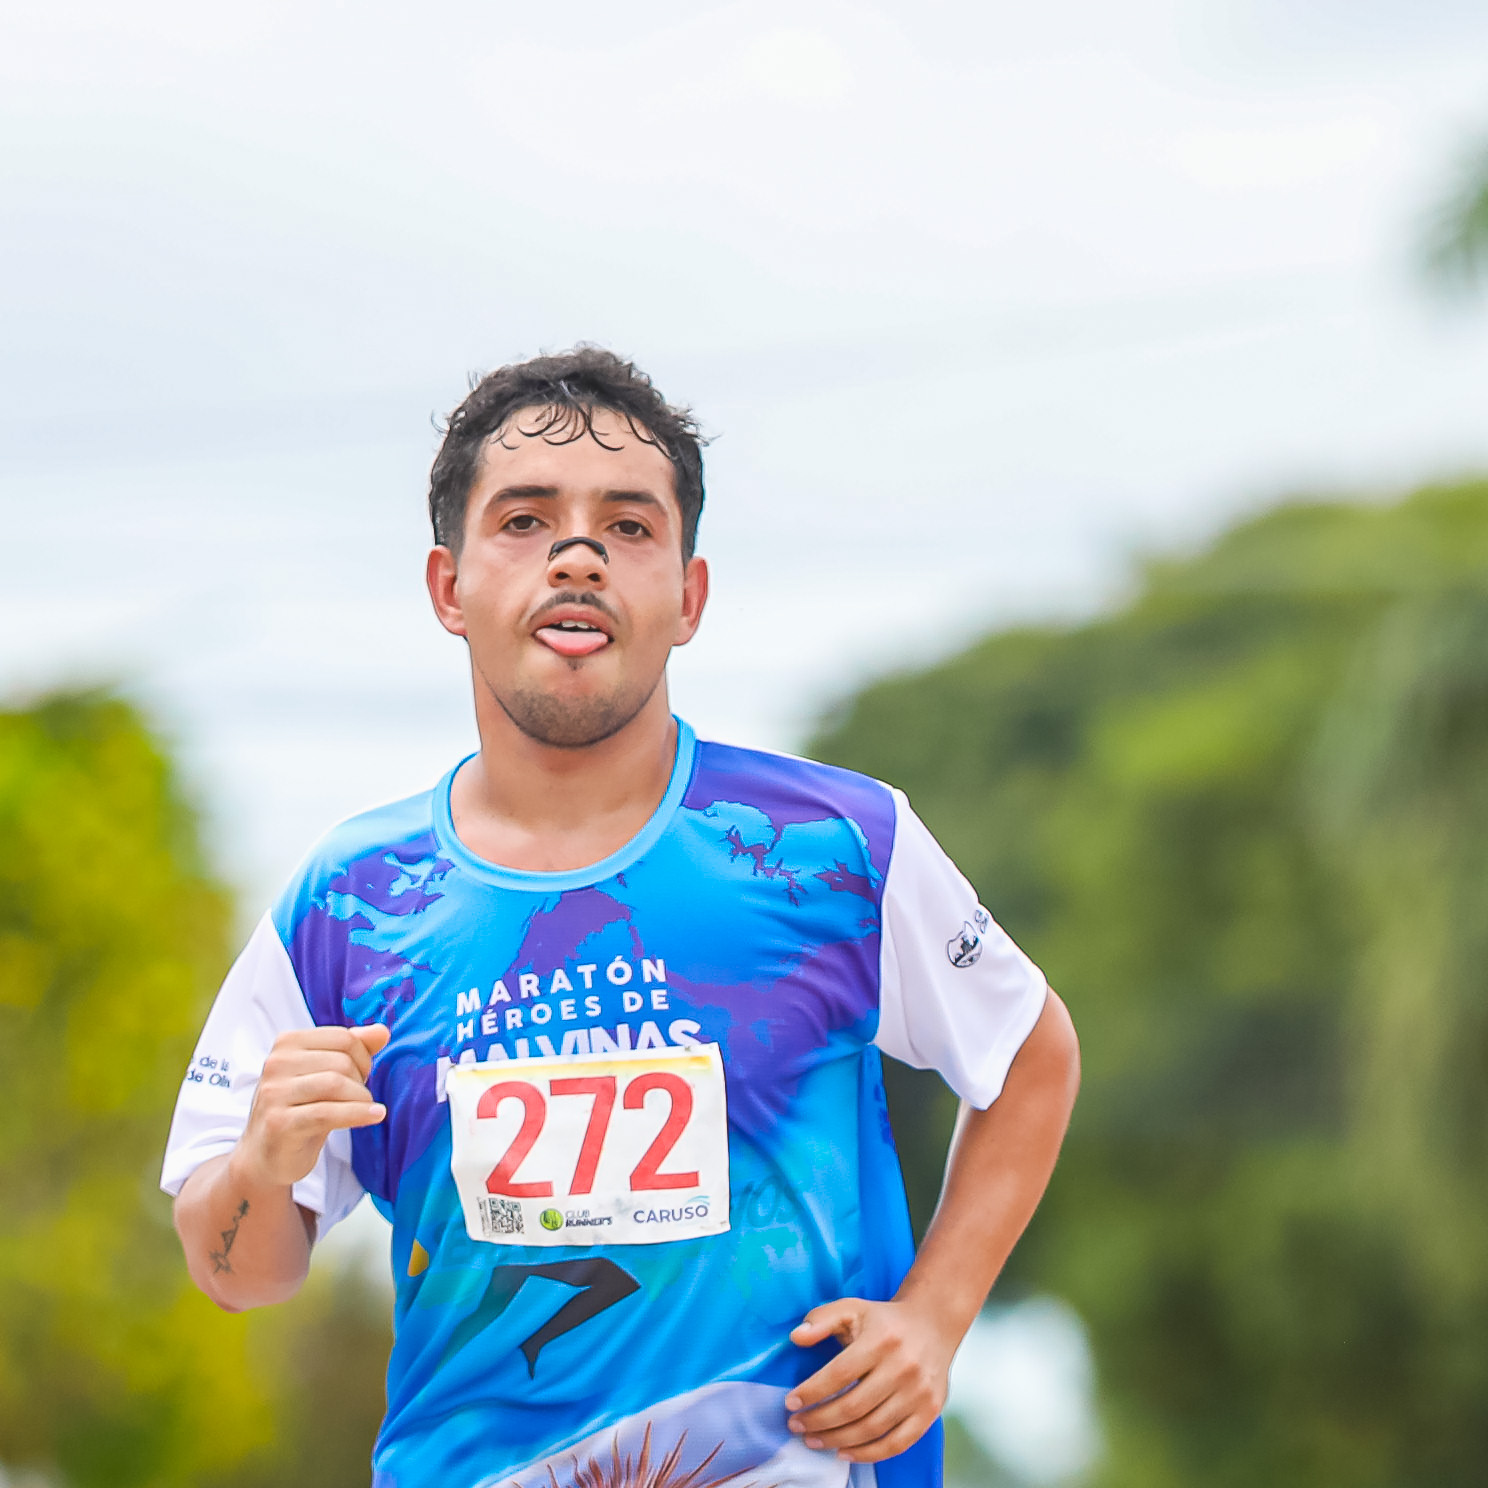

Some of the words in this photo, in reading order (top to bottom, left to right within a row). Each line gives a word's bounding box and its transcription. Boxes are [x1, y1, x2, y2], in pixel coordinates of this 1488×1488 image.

[456, 955, 667, 1017] MARATÓN
[456, 995, 602, 1043] HÉROES
[623, 989, 670, 1013] DE
[476, 1072, 701, 1198] 272
[633, 1204, 709, 1224] CARUSO
